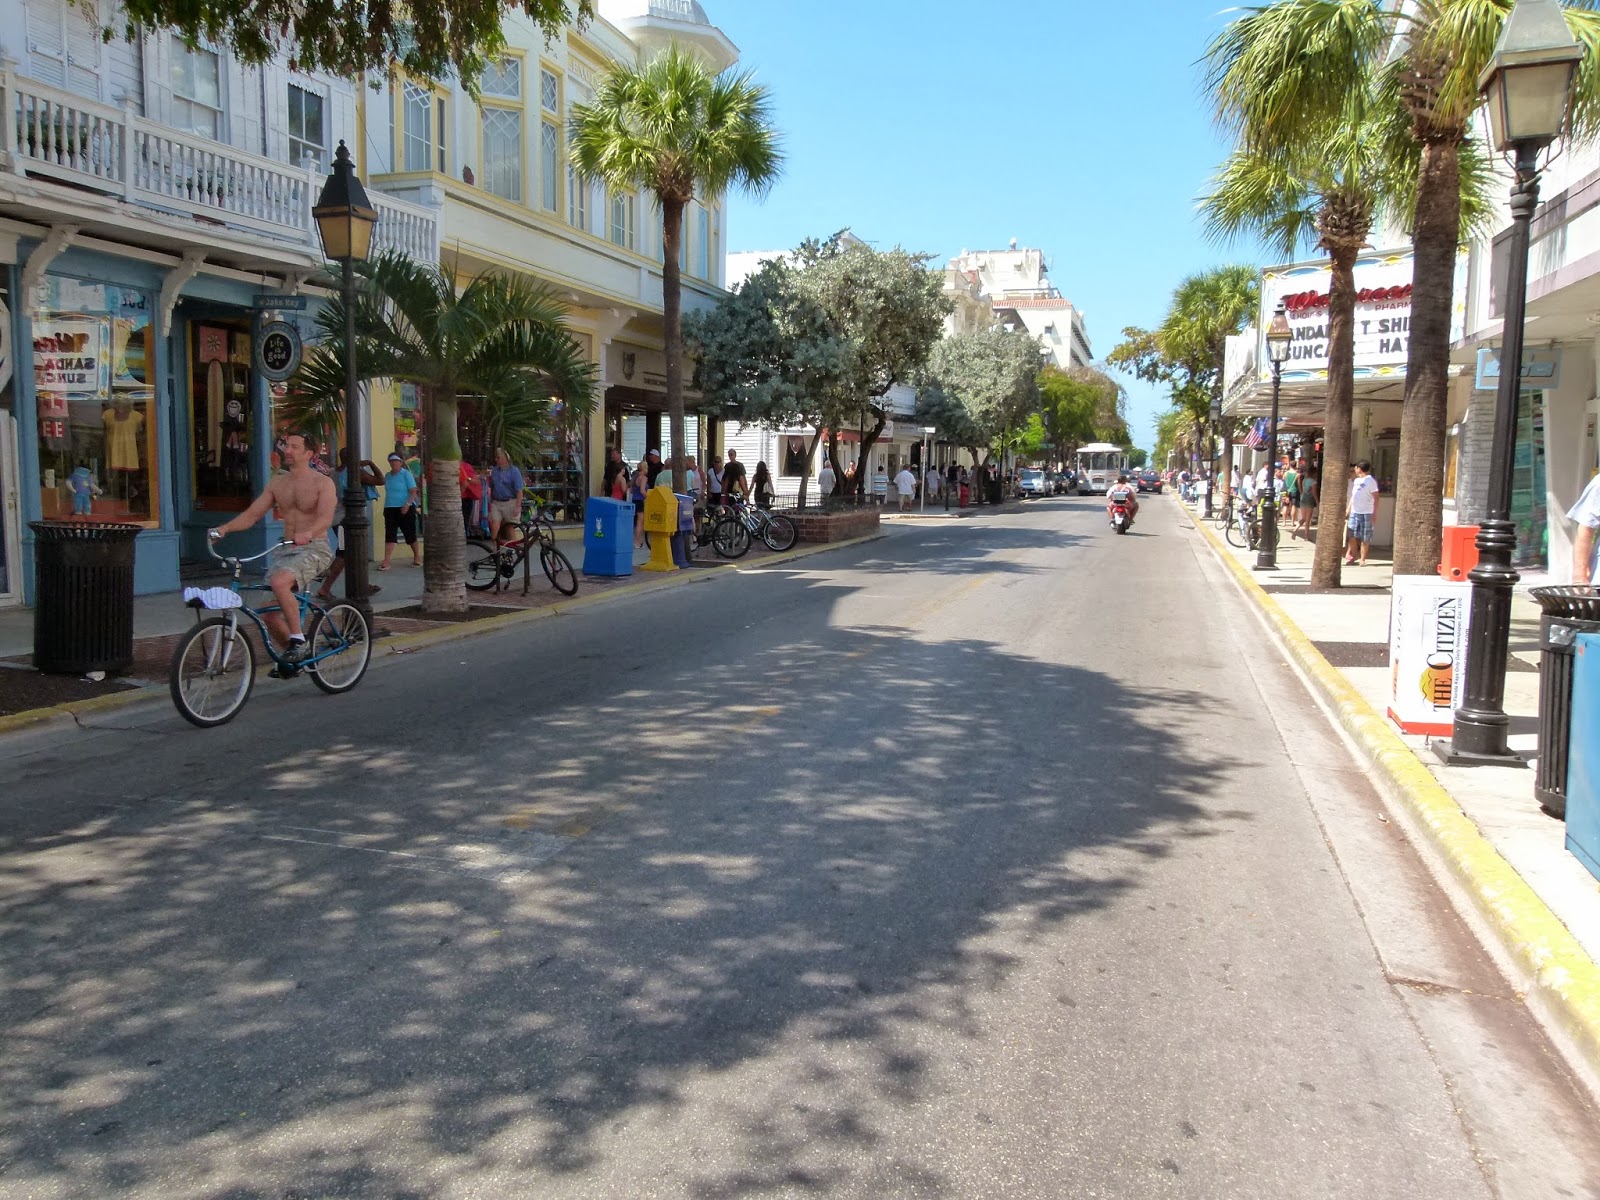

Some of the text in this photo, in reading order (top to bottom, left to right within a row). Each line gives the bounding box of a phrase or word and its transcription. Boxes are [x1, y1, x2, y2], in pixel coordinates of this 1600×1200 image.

[1375, 301, 1412, 311] PHARM
[1360, 320, 1371, 335] T
[1378, 316, 1411, 334] SHI
[270, 337, 285, 348] Life
[1379, 337, 1409, 354] HA
[1426, 597, 1457, 712] THE CITIZEN
